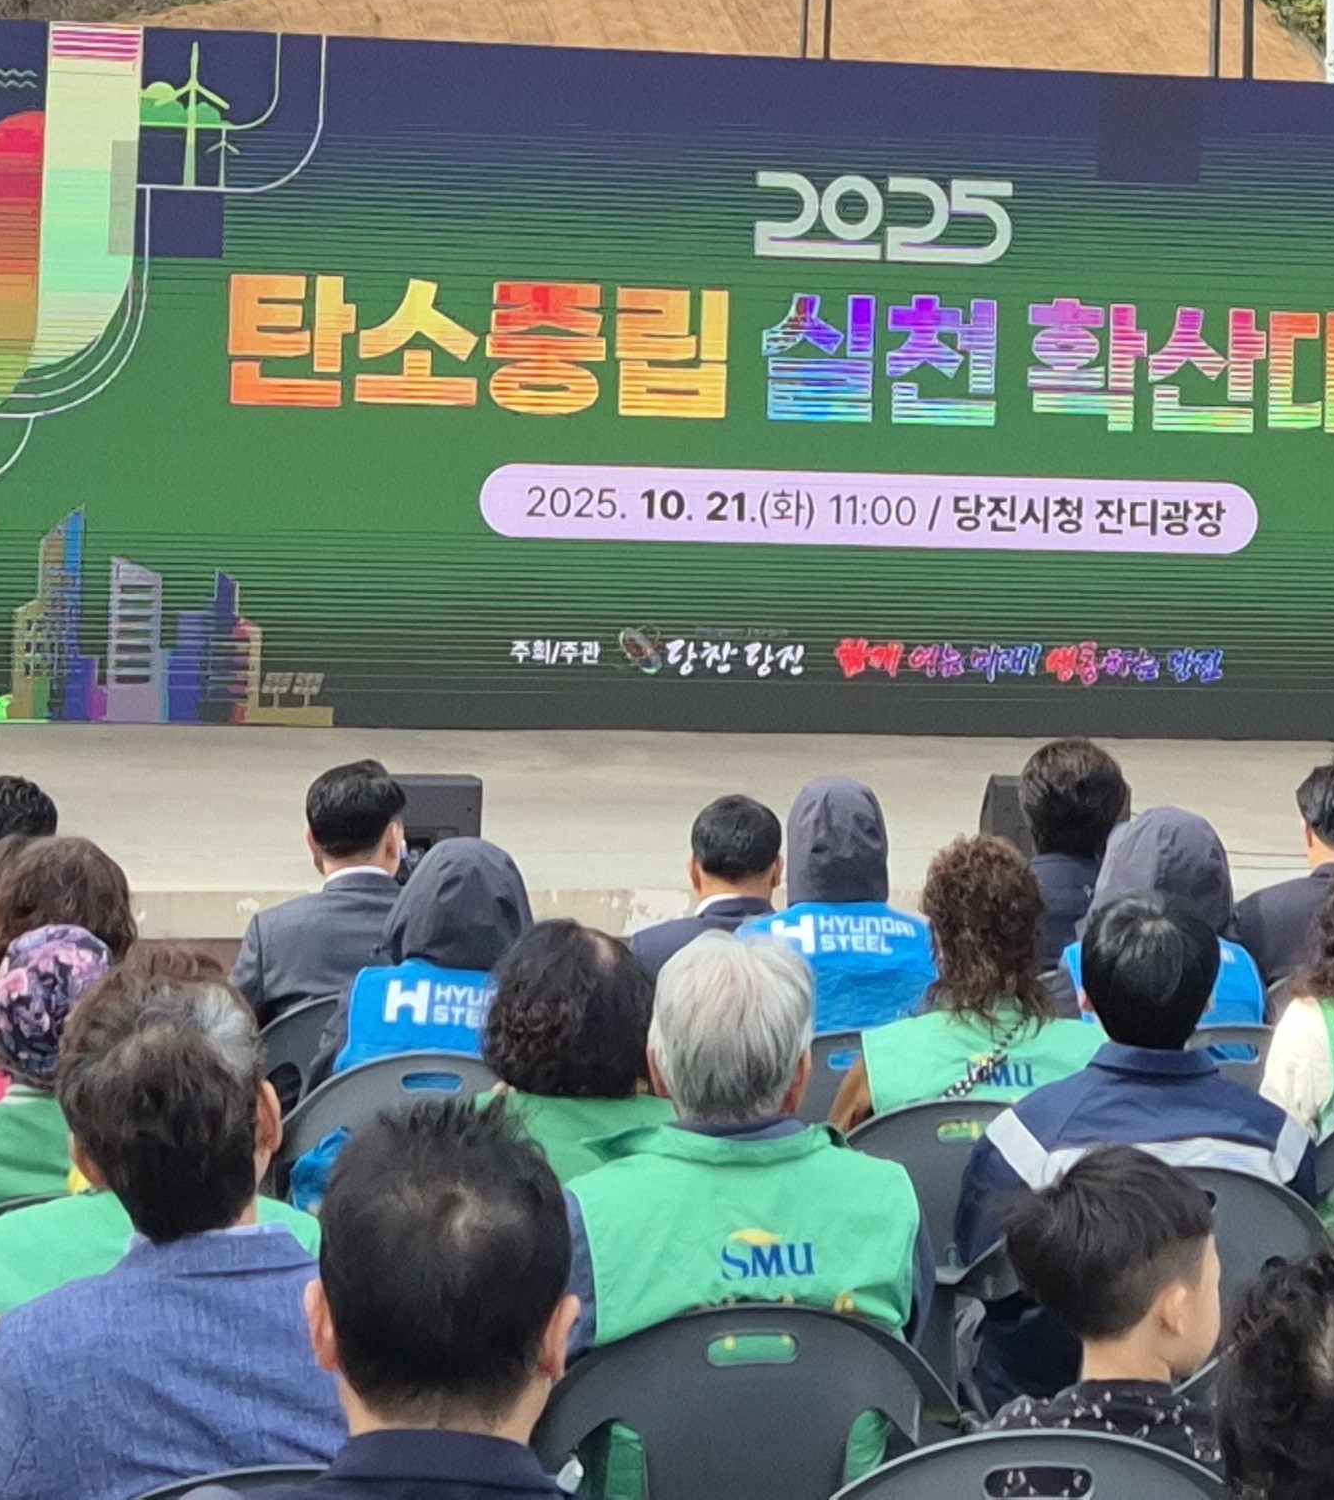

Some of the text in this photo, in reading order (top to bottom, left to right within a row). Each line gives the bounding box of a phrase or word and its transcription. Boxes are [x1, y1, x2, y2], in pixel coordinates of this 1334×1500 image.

[754, 171, 1014, 265] 2025
[228, 273, 730, 419] 탄소중립
[761, 293, 998, 427] 실천
[525, 486, 628, 520] 2025.
[639, 488, 693, 522] 10.
[828, 493, 917, 527] 11:00
[927, 495, 942, 531] /
[952, 494, 1084, 534] 당진시청
[1094, 498, 1227, 538] 잔디광장
[818, 913, 917, 938] HYUNDAI
[820, 934, 894, 956] STEEL
[720, 1241, 815, 1282] SMU
